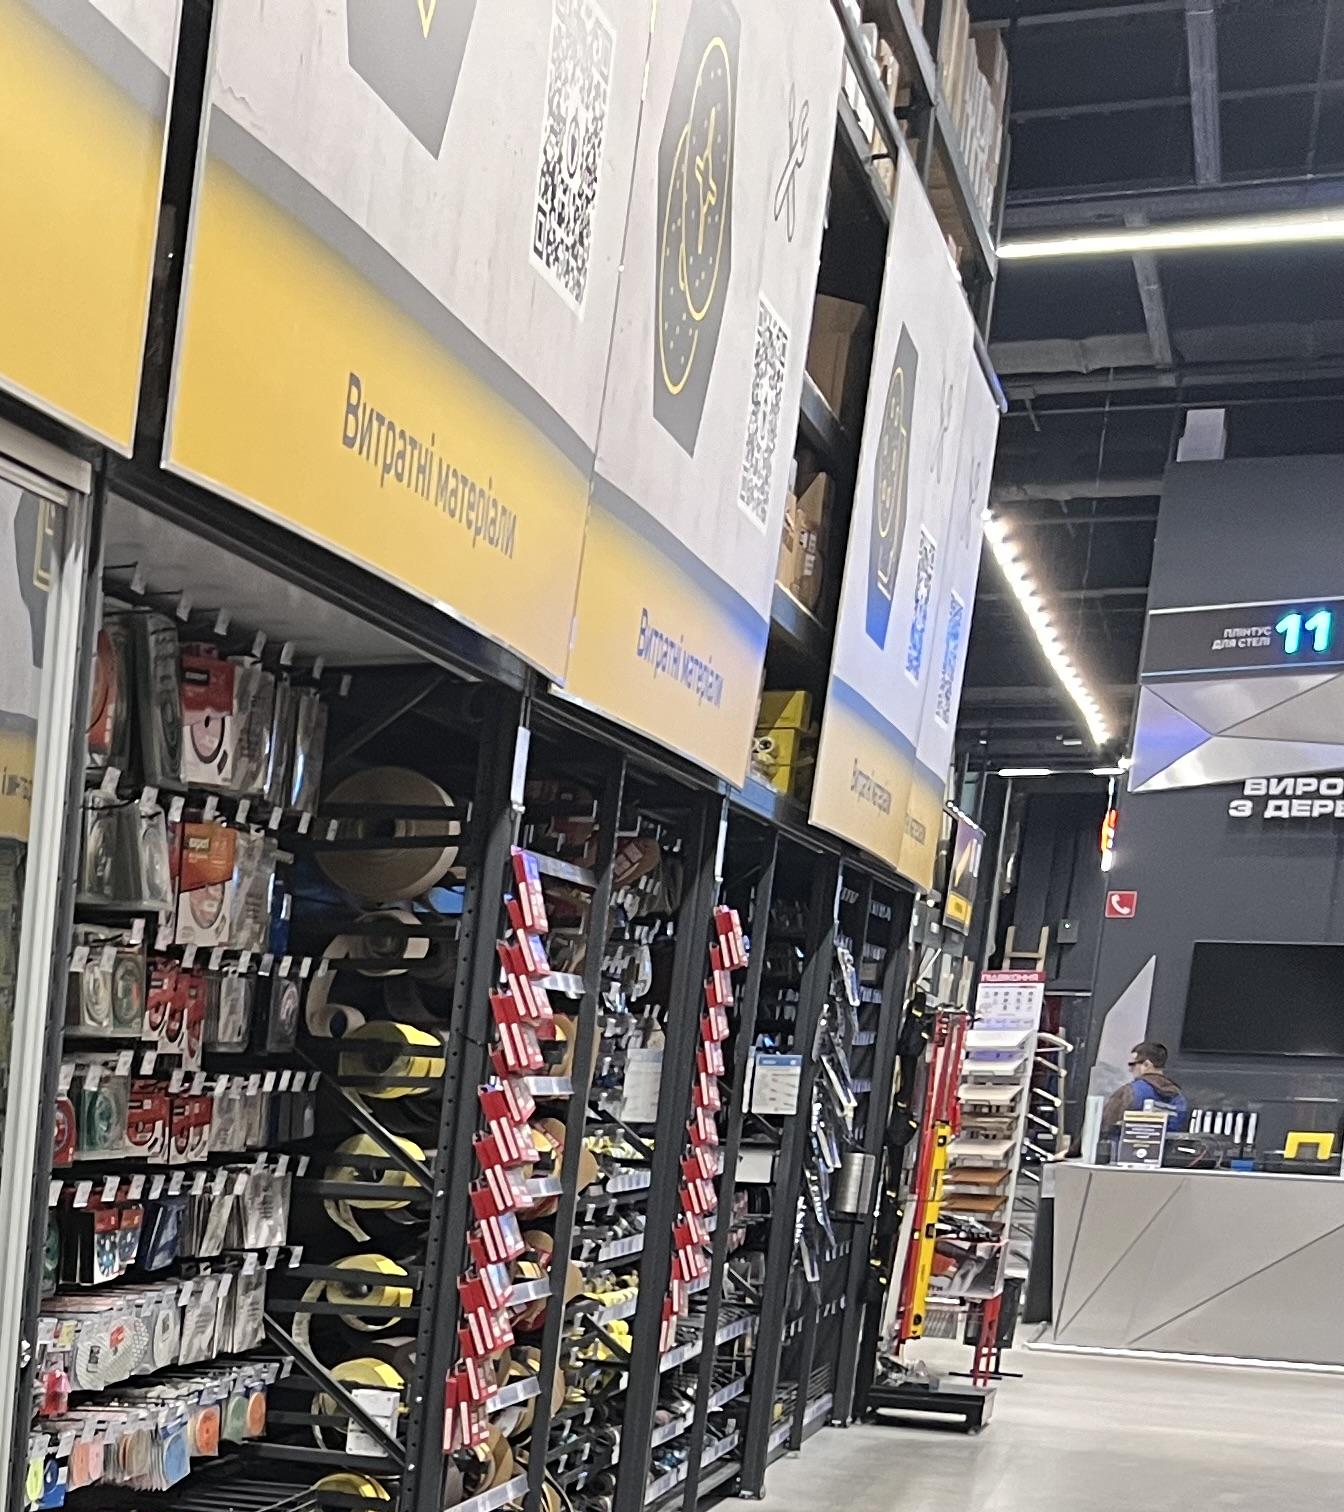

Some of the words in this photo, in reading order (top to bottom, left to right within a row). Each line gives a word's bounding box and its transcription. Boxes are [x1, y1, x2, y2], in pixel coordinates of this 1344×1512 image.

[343, 372, 435, 500] Витратні
[435, 457, 517, 559] матеріали
[1212, 639, 1236, 650] ДЛЯ
[1238, 637, 1271, 648] СТЕЛІ
[1224, 626, 1272, 638] ПЛІНТУС
[1275, 610, 1332, 654] 11
